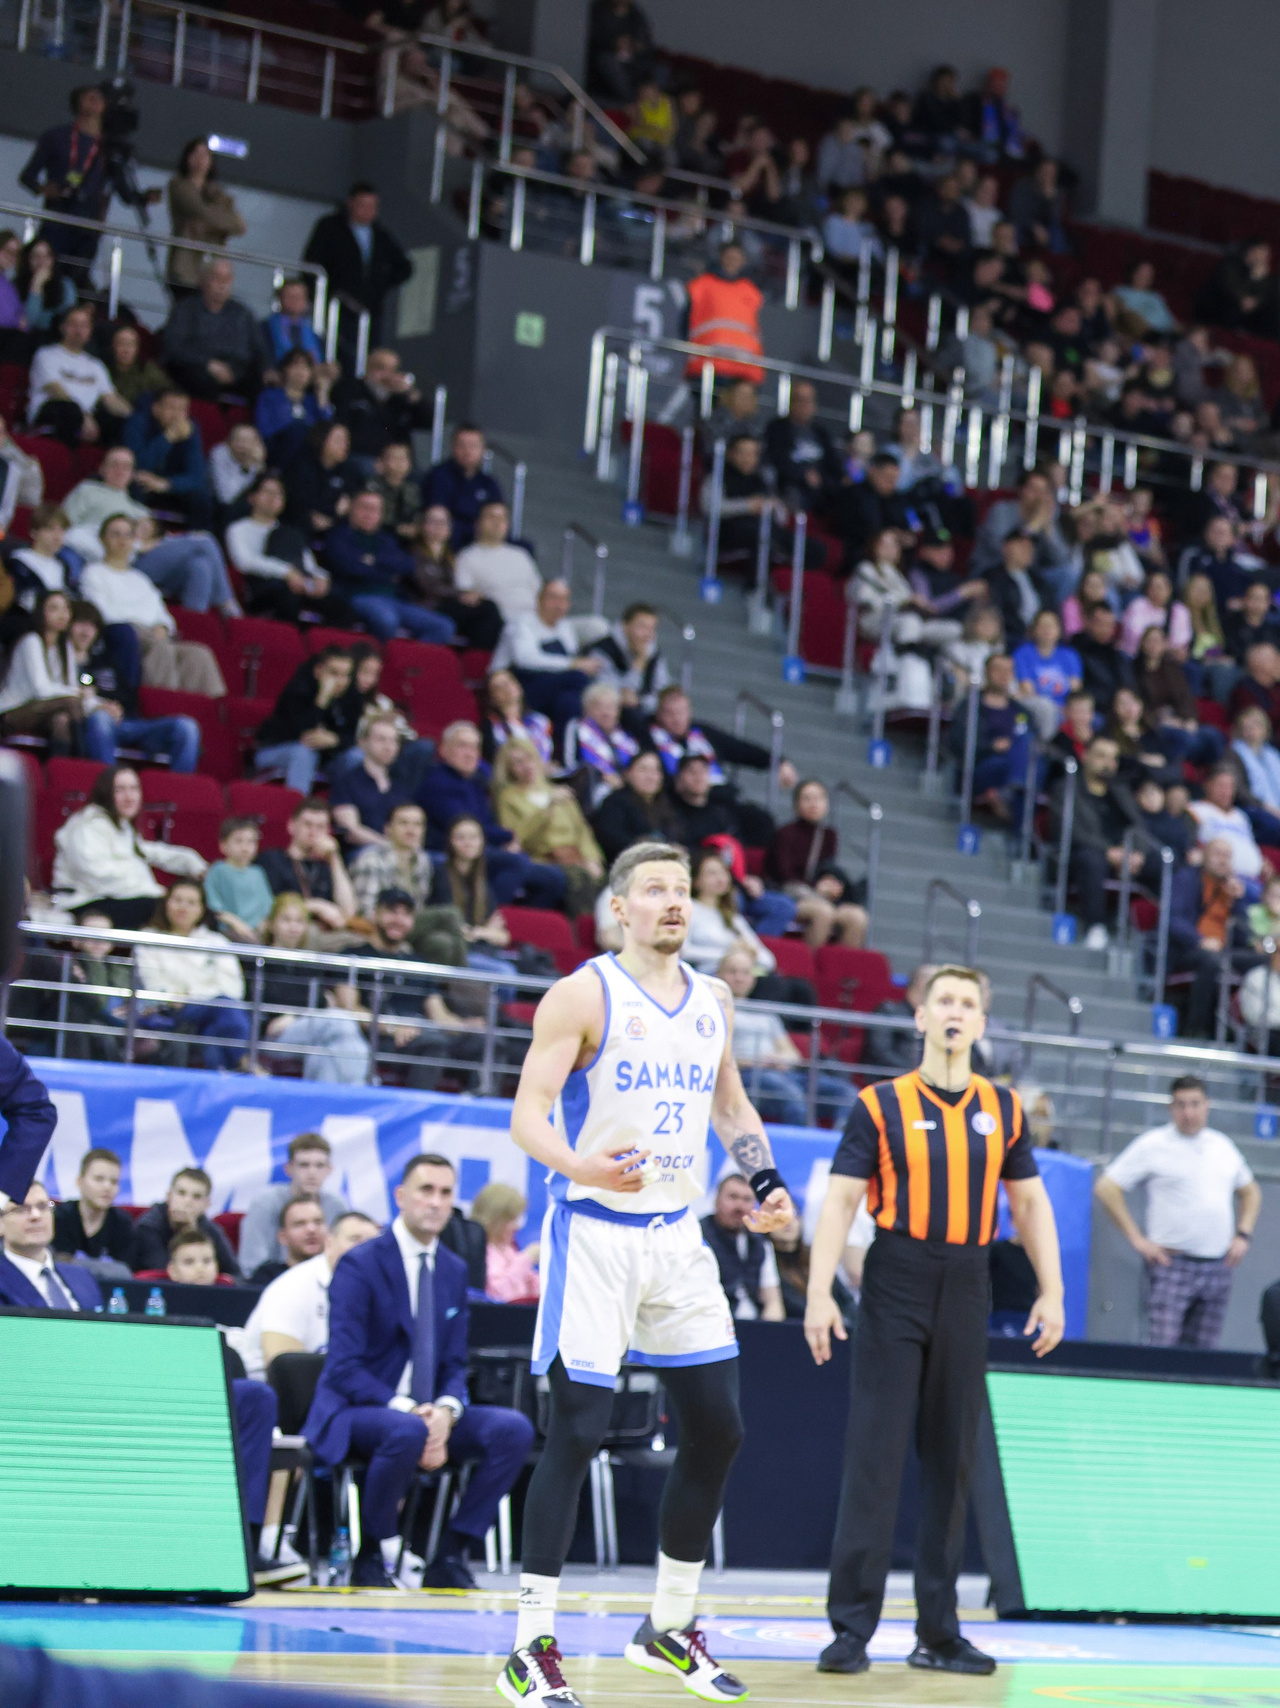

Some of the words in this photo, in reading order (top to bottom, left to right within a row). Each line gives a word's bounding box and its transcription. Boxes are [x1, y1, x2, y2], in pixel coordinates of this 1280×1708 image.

[634, 284, 664, 340] 5
[615, 1060, 714, 1093] SAMARA
[652, 1101, 686, 1135] 23
